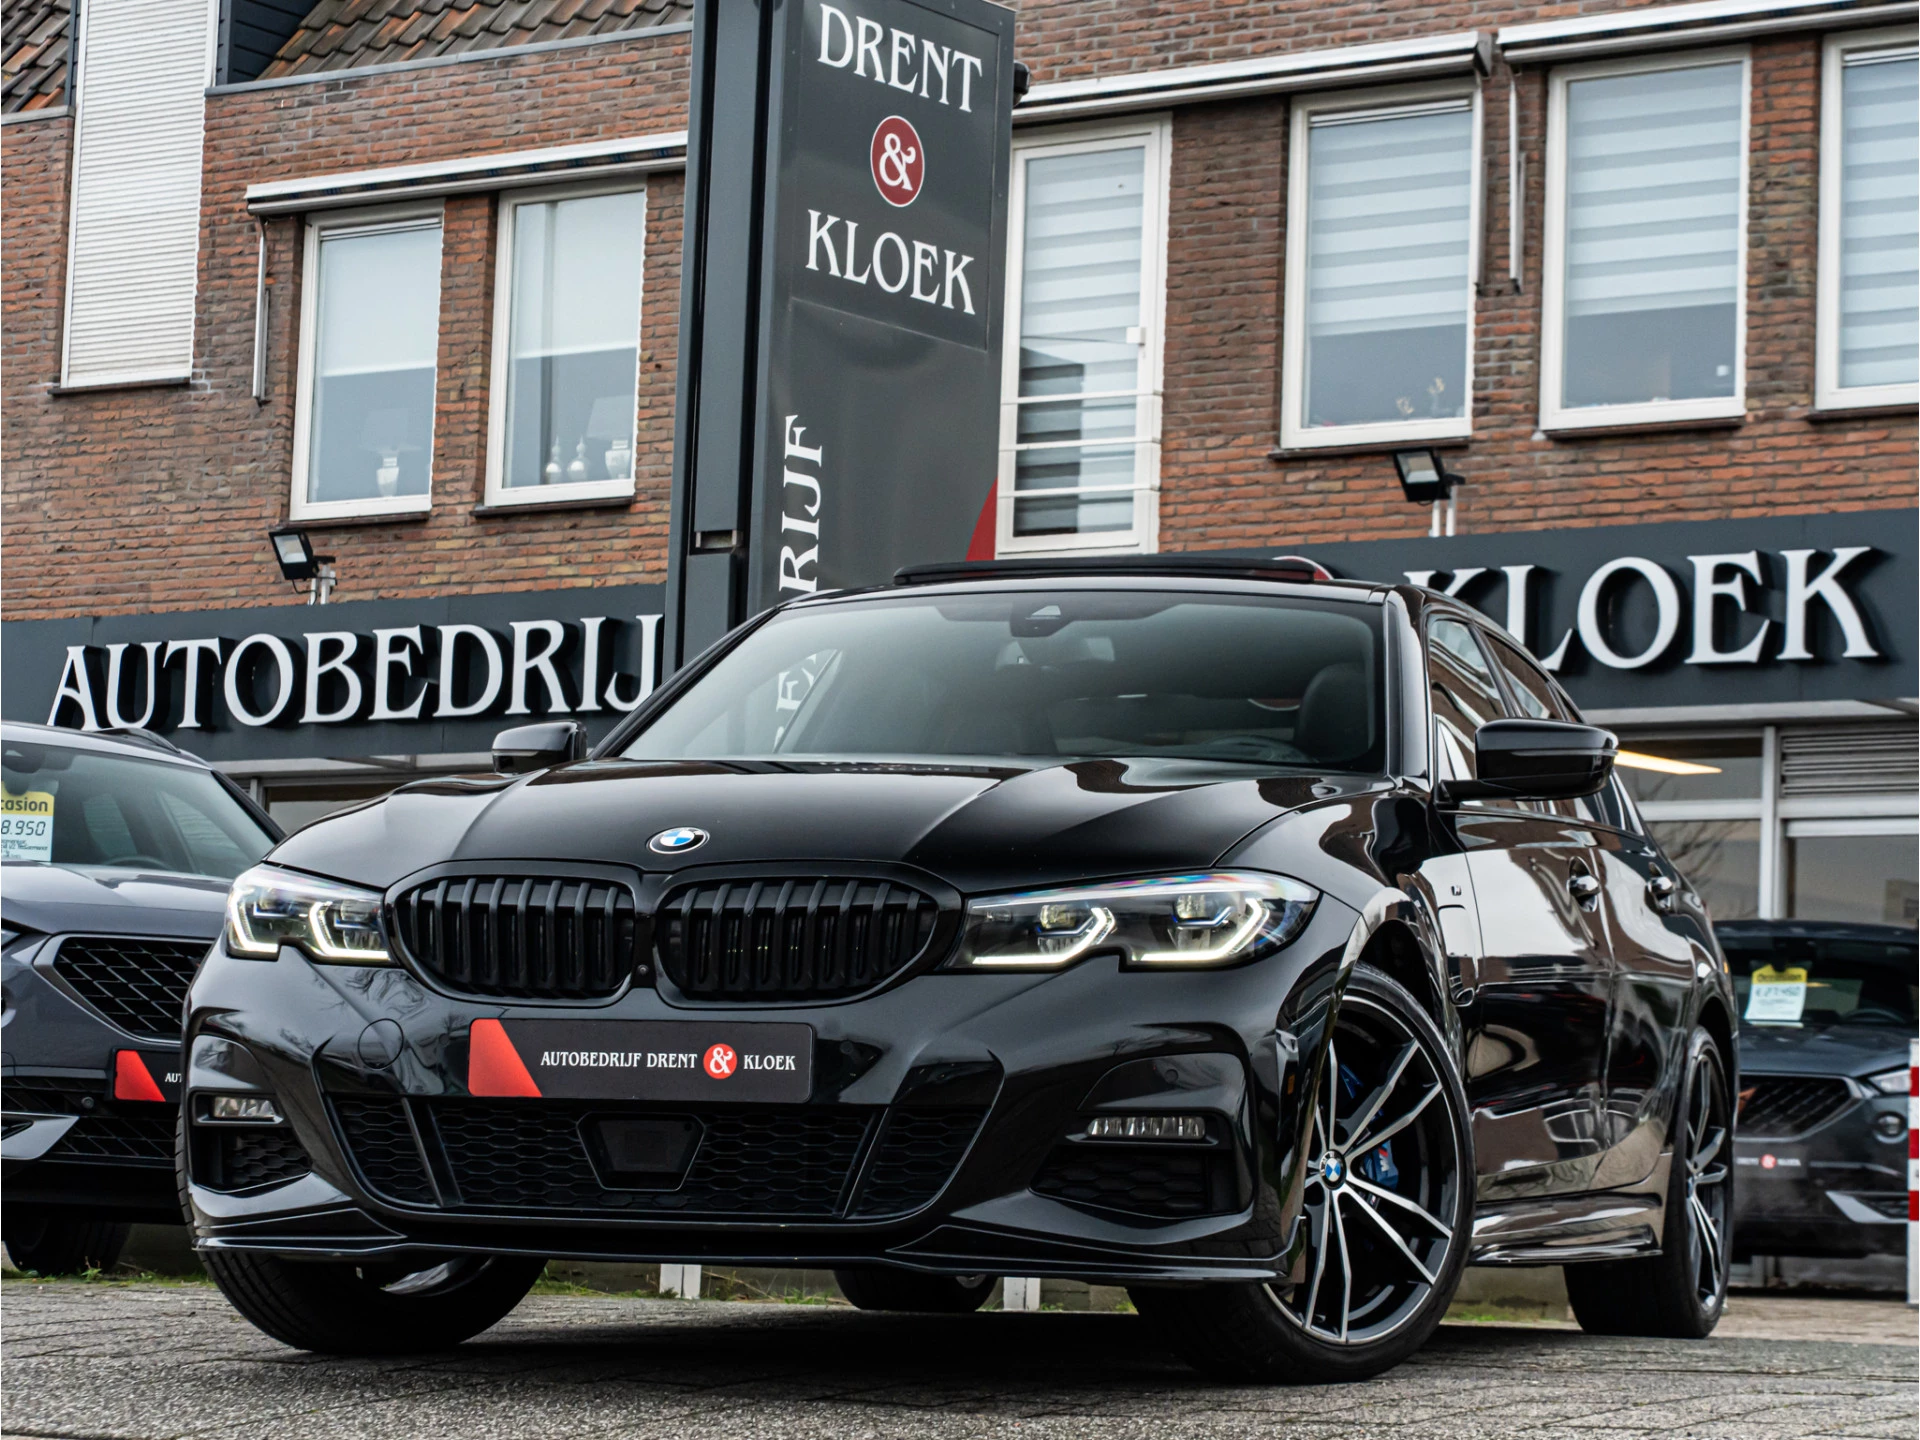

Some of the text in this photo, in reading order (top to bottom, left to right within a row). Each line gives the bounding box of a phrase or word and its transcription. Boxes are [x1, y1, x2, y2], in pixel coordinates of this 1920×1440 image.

[817, 3, 983, 113] DRENT
[879, 132, 917, 192] &
[805, 208, 976, 316] KLOEK
[540, 1046, 796, 1074] AUTOBEDRIJF DRENT & KLOEK
